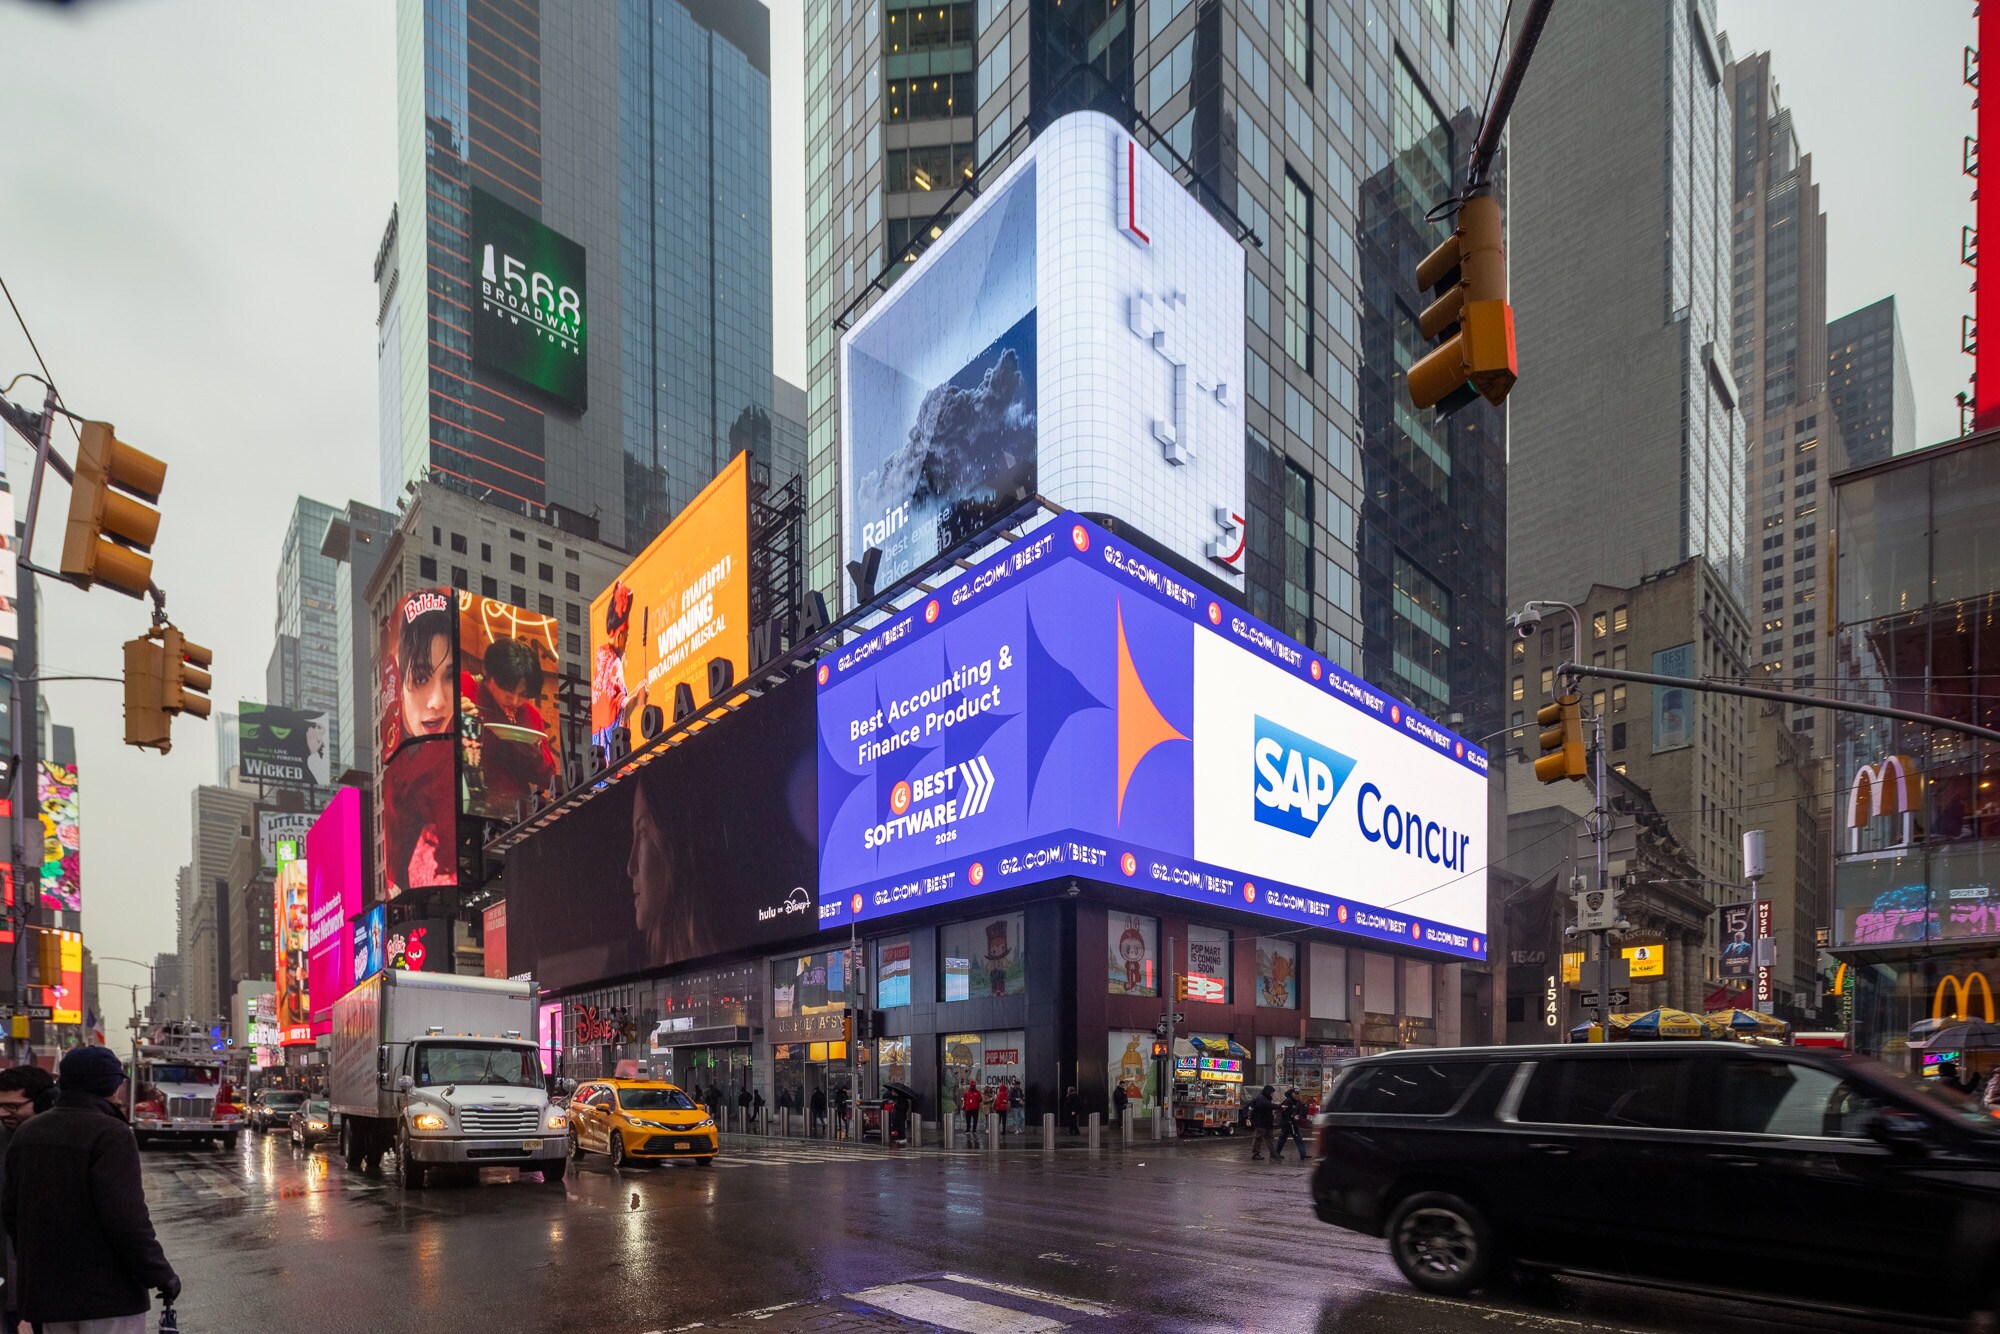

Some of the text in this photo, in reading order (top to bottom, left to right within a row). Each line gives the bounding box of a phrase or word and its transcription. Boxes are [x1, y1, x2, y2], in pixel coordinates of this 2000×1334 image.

[482, 244, 580, 325] 1568
[482, 281, 579, 338] BROADWAY
[483, 302, 580, 355] NEW YORK
[862, 500, 909, 553] Rain:
[404, 593, 448, 624] Buldak
[658, 592, 713, 659] WINNING
[588, 547, 882, 779] BROADWAY
[647, 613, 726, 685] BROADWAY MUSICAL
[850, 645, 1013, 741] Best Accounting &
[858, 684, 1001, 765] Finance Product
[913, 765, 957, 802] BEST
[1255, 737, 1470, 873] SAP Concur
[268, 816, 304, 830] LITTLE
[864, 799, 957, 850] SOFTWARE
[935, 829, 957, 845] 2026
[759, 907, 776, 921] hulu
[1725, 912, 1747, 933] 15
[1190, 943, 1221, 957] POP MART
[1190, 953, 1222, 966] IS COMING
[1197, 963, 1215, 974] SOON
[1546, 976, 1557, 1026] 1540
